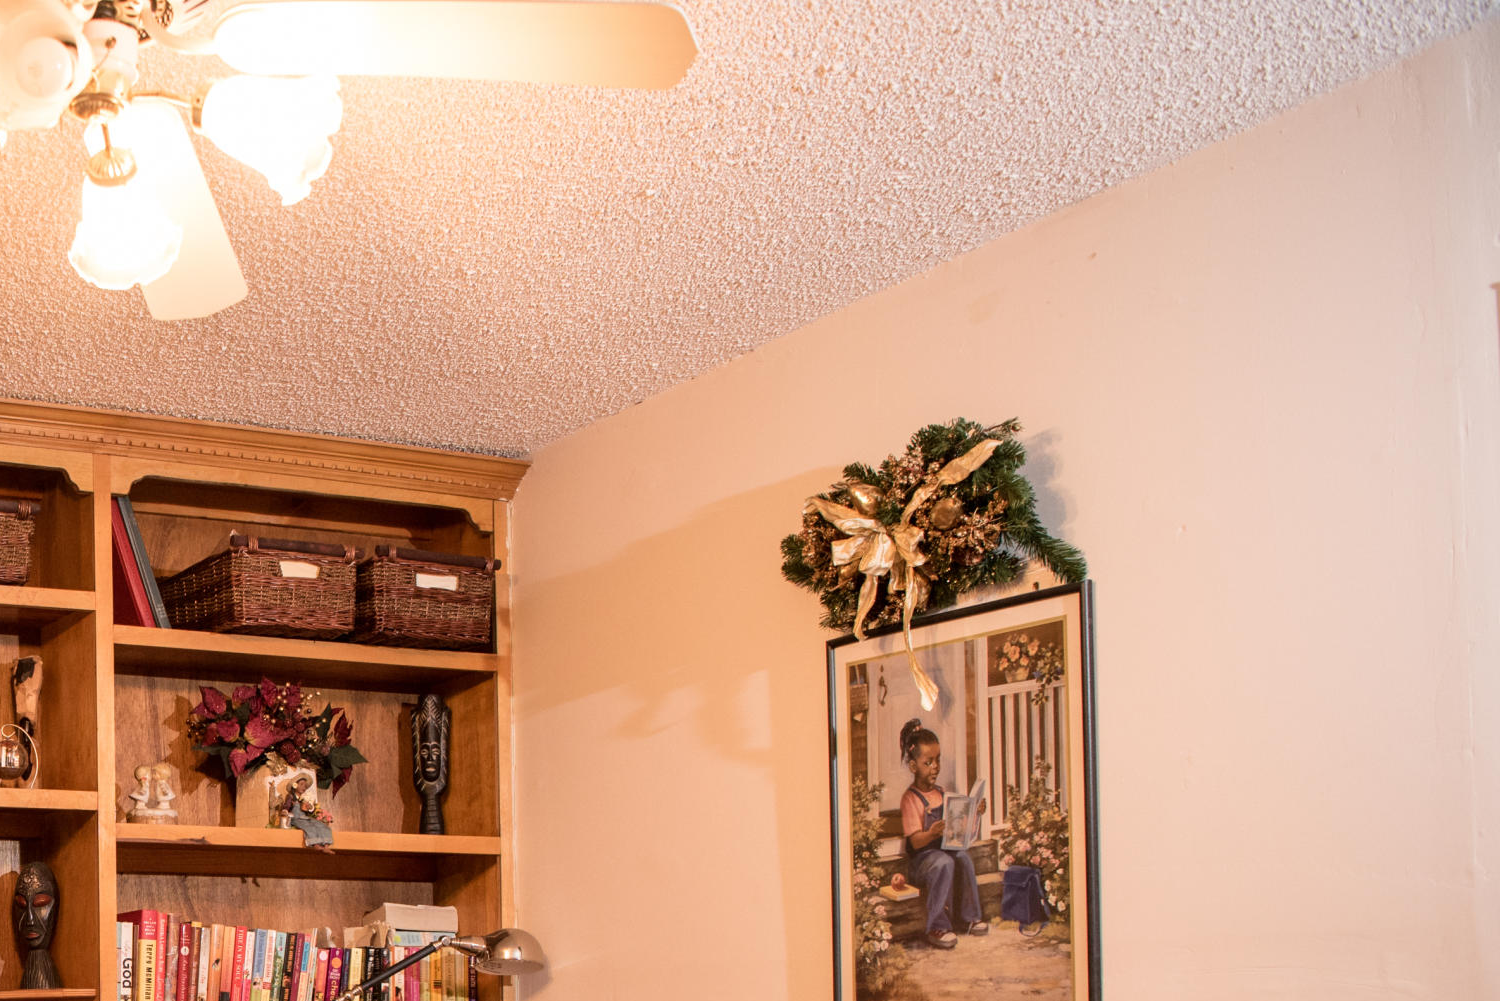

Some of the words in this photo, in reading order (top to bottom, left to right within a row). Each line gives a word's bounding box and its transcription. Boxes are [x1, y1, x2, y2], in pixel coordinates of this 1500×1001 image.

[123, 958, 132, 988] God
[236, 954, 243, 962] MY
[145, 967, 153, 1000] McMillan
